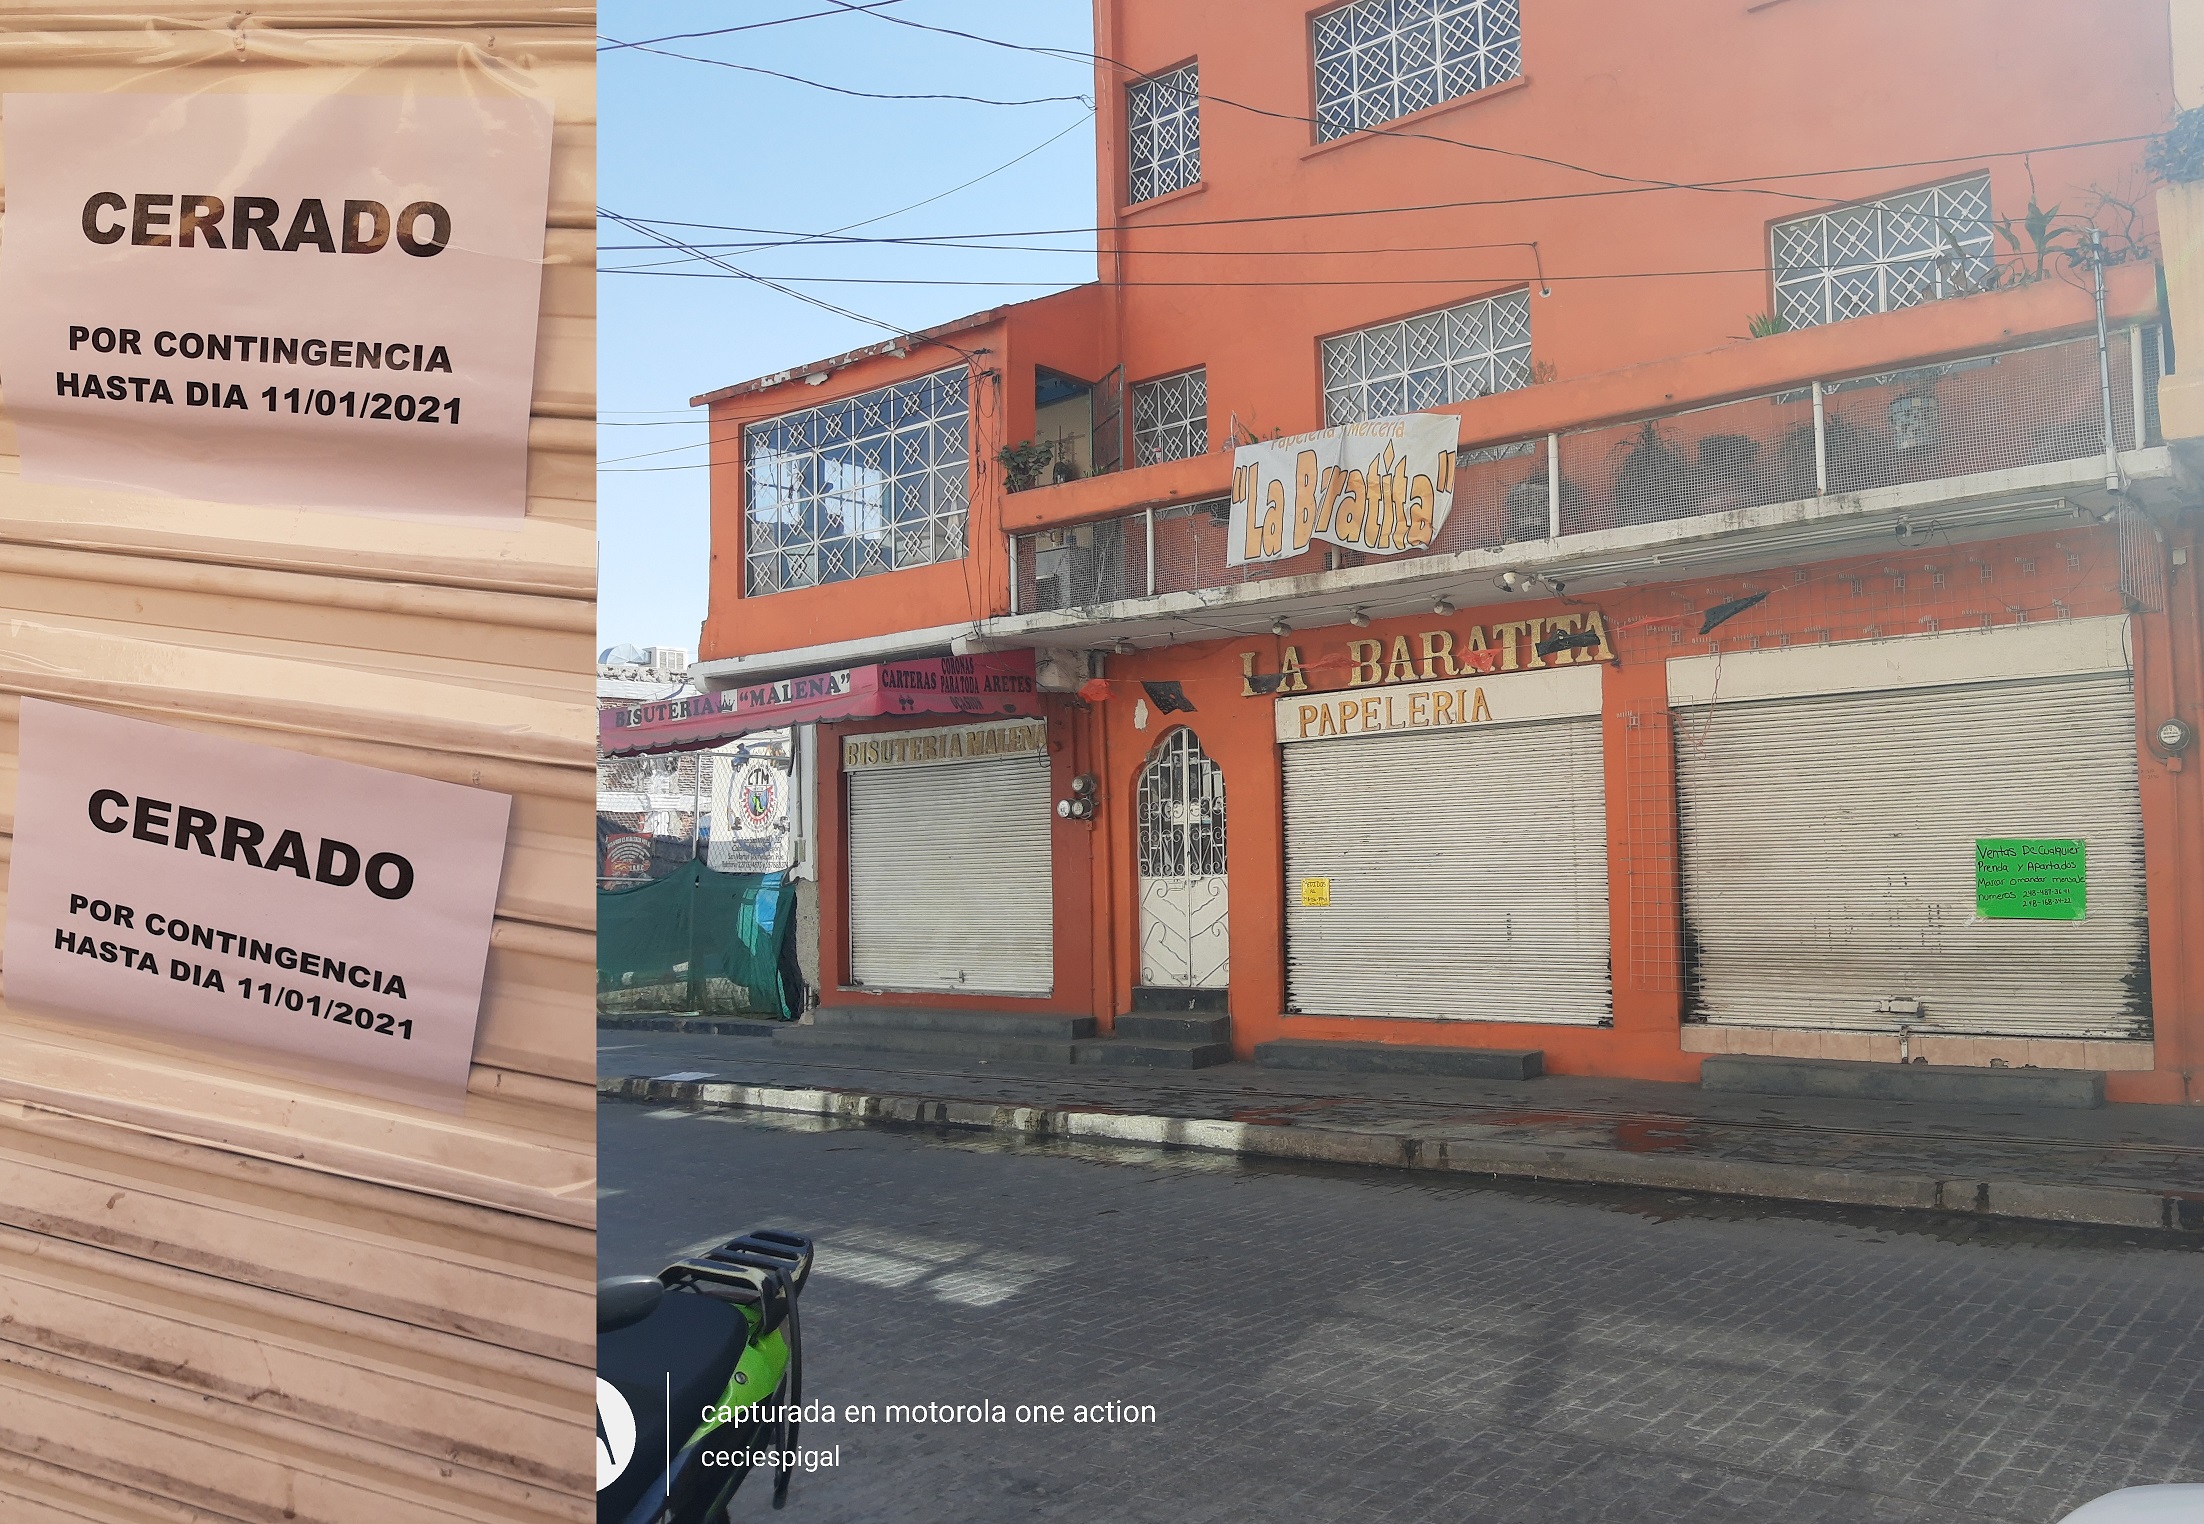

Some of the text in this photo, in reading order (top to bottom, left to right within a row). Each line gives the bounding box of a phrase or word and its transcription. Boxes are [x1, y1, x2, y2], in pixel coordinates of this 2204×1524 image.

[81, 191, 452, 258] CERRADO
[69, 325, 453, 374] POR CONTINGENCIA
[56, 371, 461, 425] HASTA DIA 11/01/2021
[940, 656, 975, 675] CORONAS
[1239, 610, 1616, 698] LA BARATITA
[881, 669, 937, 690] CARTERAS
[940, 676, 980, 694] PARA TODA
[983, 675, 1032, 694] ARETES
[615, 699, 715, 728] BISUTERIA
[1298, 686, 1493, 739] PAPELERIA
[845, 723, 1048, 767] BISUTERIA MALENA
[88, 788, 415, 901] CERRADO
[1976, 844, 2017, 859] Ventas
[1977, 861, 2009, 872] Prenda
[2027, 860, 2077, 872] Apartados
[69, 893, 408, 1000] POR CONTINGENCIA
[54, 927, 413, 1041] HASTA DIA 11/01/2021
